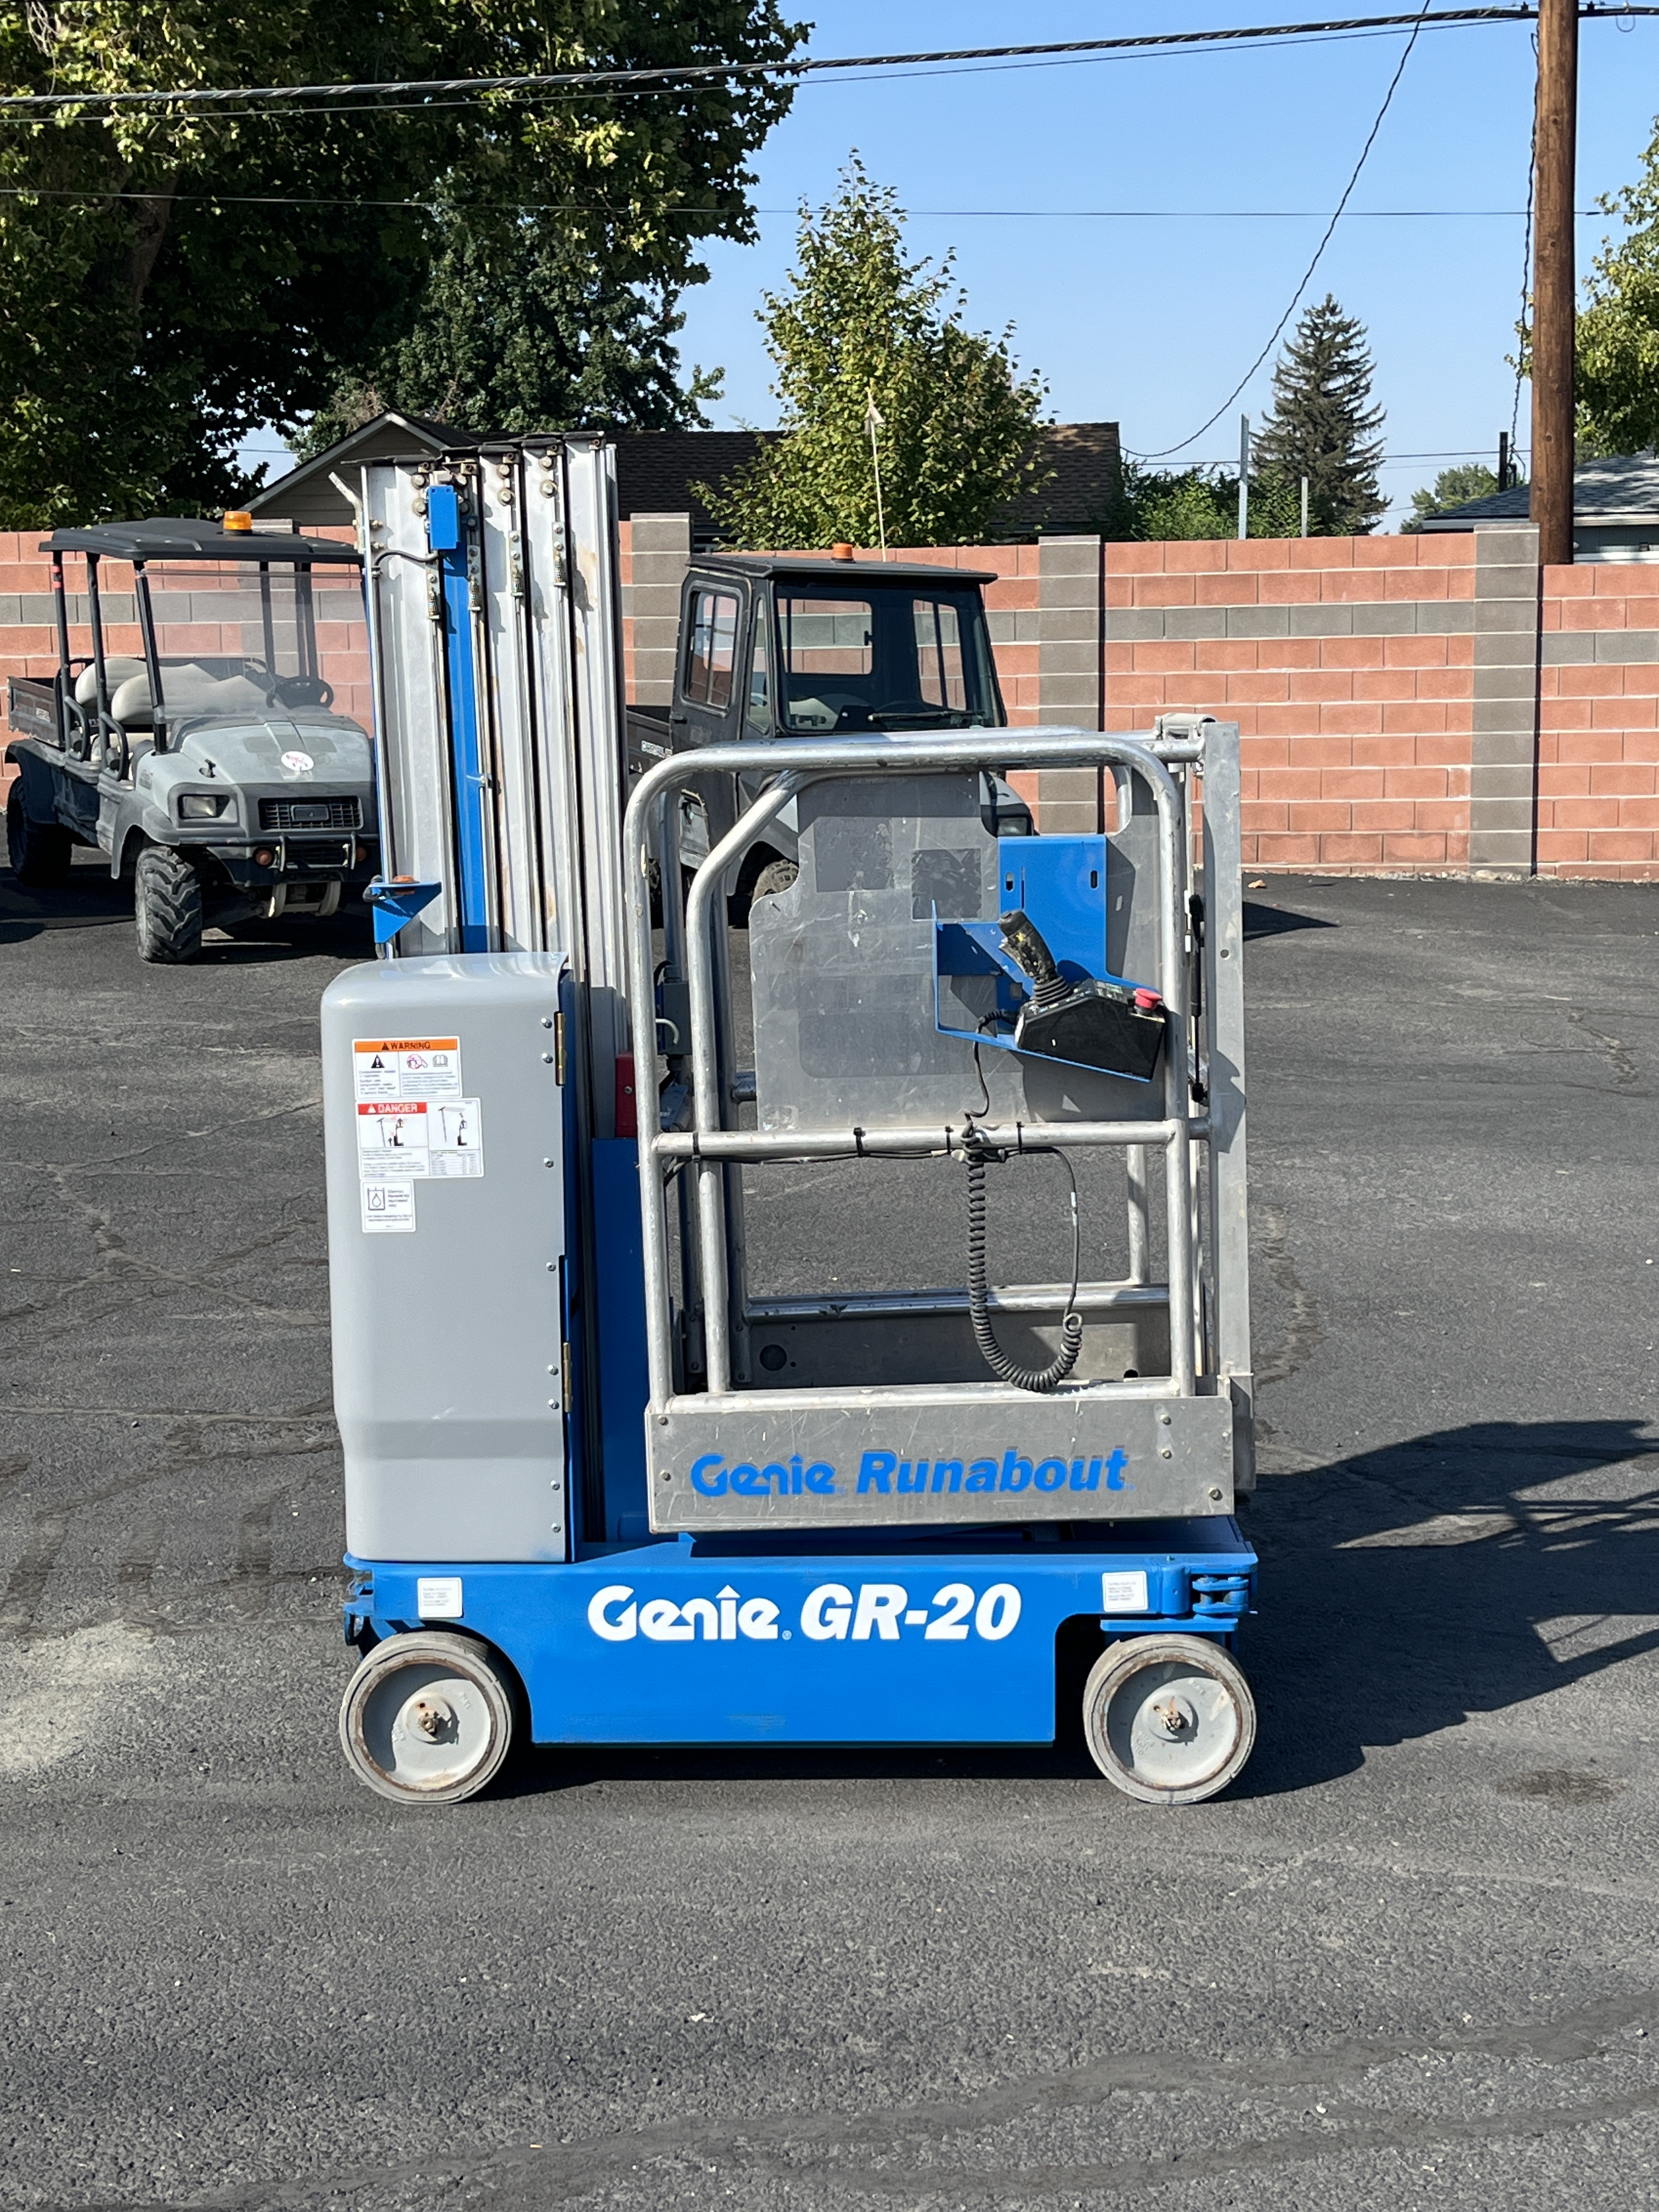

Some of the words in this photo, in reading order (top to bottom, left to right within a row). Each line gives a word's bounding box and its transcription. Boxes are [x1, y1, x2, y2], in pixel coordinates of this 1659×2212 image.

[390, 1041, 431, 1050] WARNING
[377, 1102, 418, 1114] DANGER
[690, 1452, 836, 1497] Genie
[856, 1446, 1129, 1494] Runabout
[588, 1584, 781, 1641] Genie
[800, 1583, 1022, 1641] GR-20
